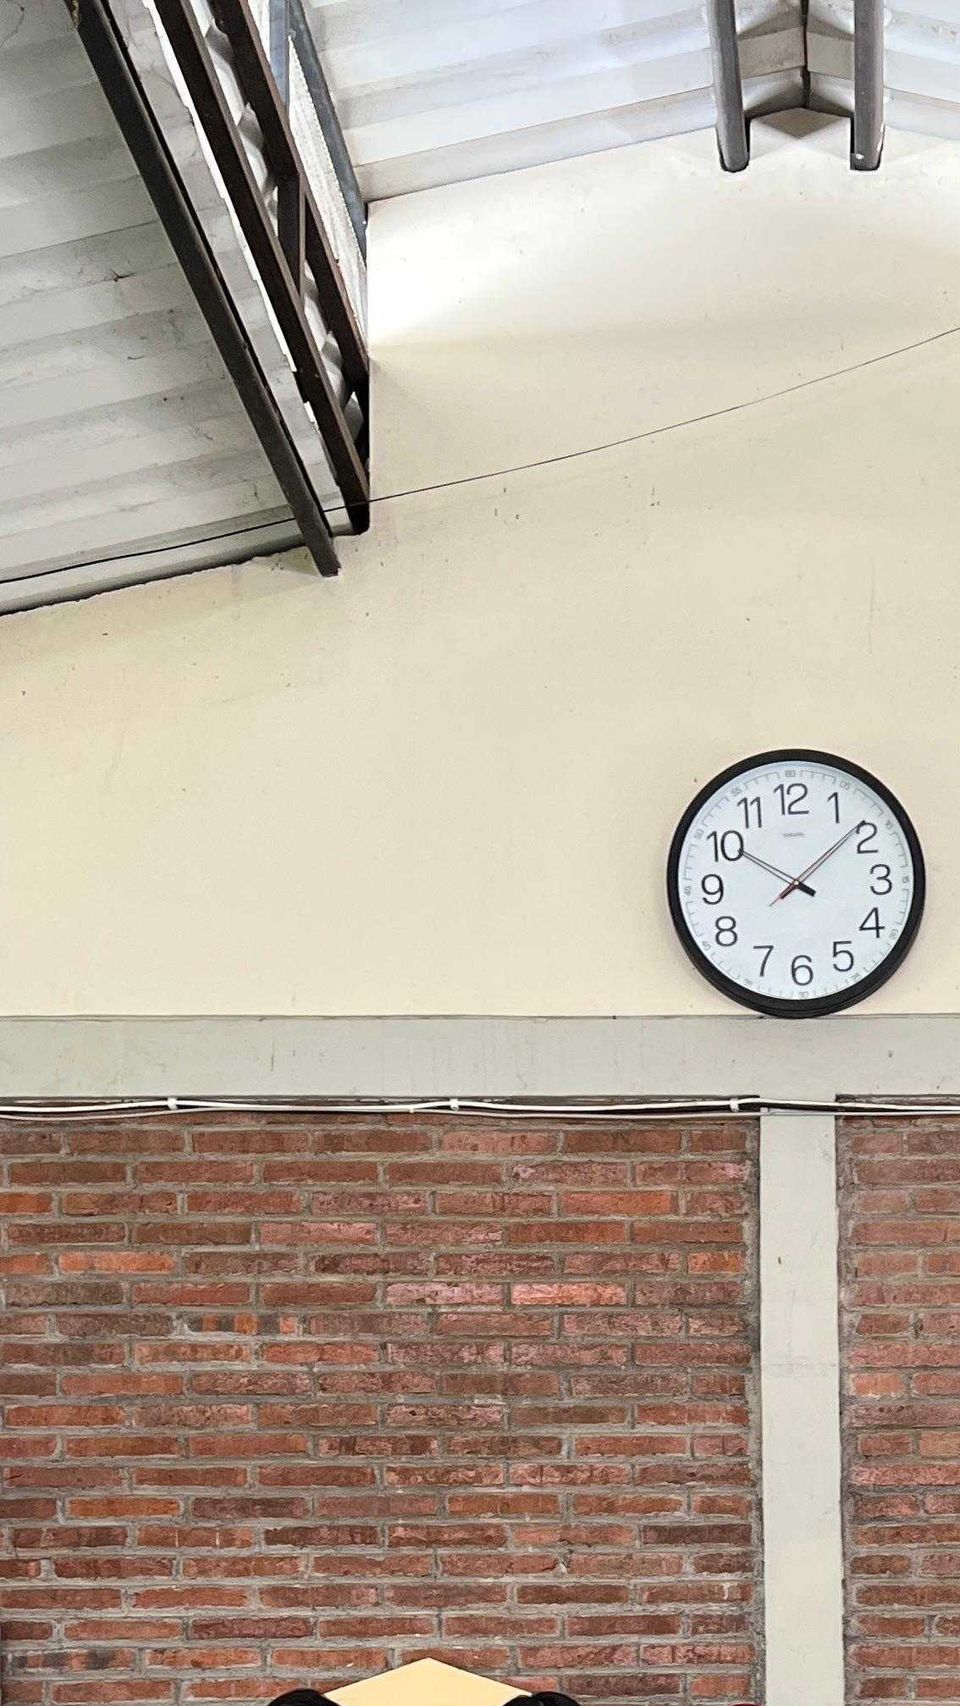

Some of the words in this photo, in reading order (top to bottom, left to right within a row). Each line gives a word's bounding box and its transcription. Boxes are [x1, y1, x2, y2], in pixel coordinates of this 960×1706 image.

[737, 796, 762, 829] 11
[773, 783, 809, 815] 12
[827, 791, 840, 824] 1
[706, 829, 744, 862] 10
[856, 822, 878, 854] 2
[701, 873, 724, 905] 9
[870, 863, 893, 896] 3
[715, 915, 738, 947] 8
[859, 907, 885, 939] 4
[753, 945, 774, 977] 7
[791, 954, 814, 986] 6
[833, 940, 854, 972] 5
